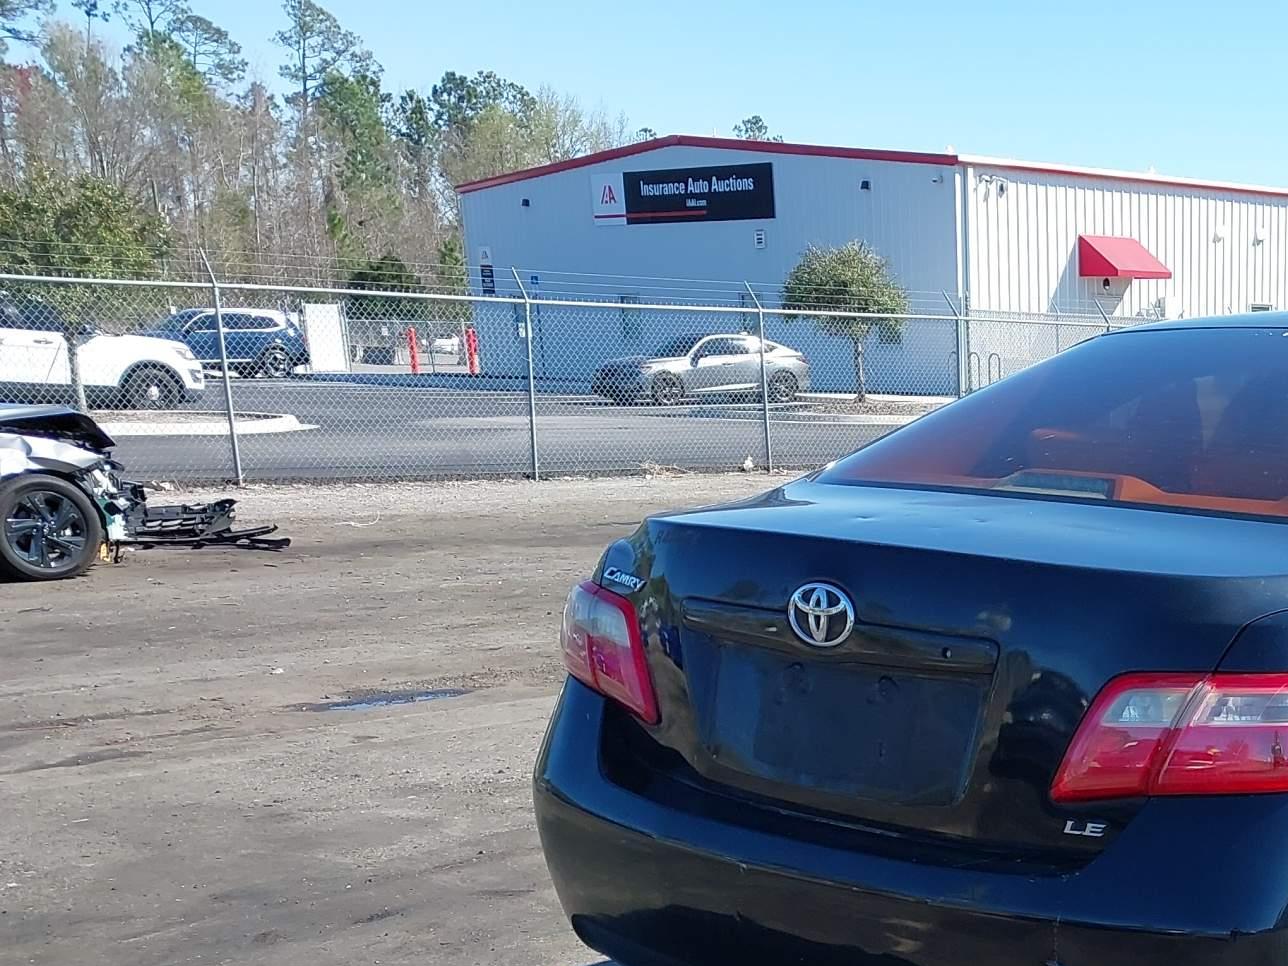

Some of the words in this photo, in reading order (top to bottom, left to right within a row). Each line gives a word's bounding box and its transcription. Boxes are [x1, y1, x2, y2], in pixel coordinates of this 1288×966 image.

[640, 180, 685, 197] Insurance
[687, 177, 709, 194] Auto
[711, 175, 754, 193] Auctions
[603, 566, 648, 592] CAMRY
[1063, 820, 1107, 837] LE
